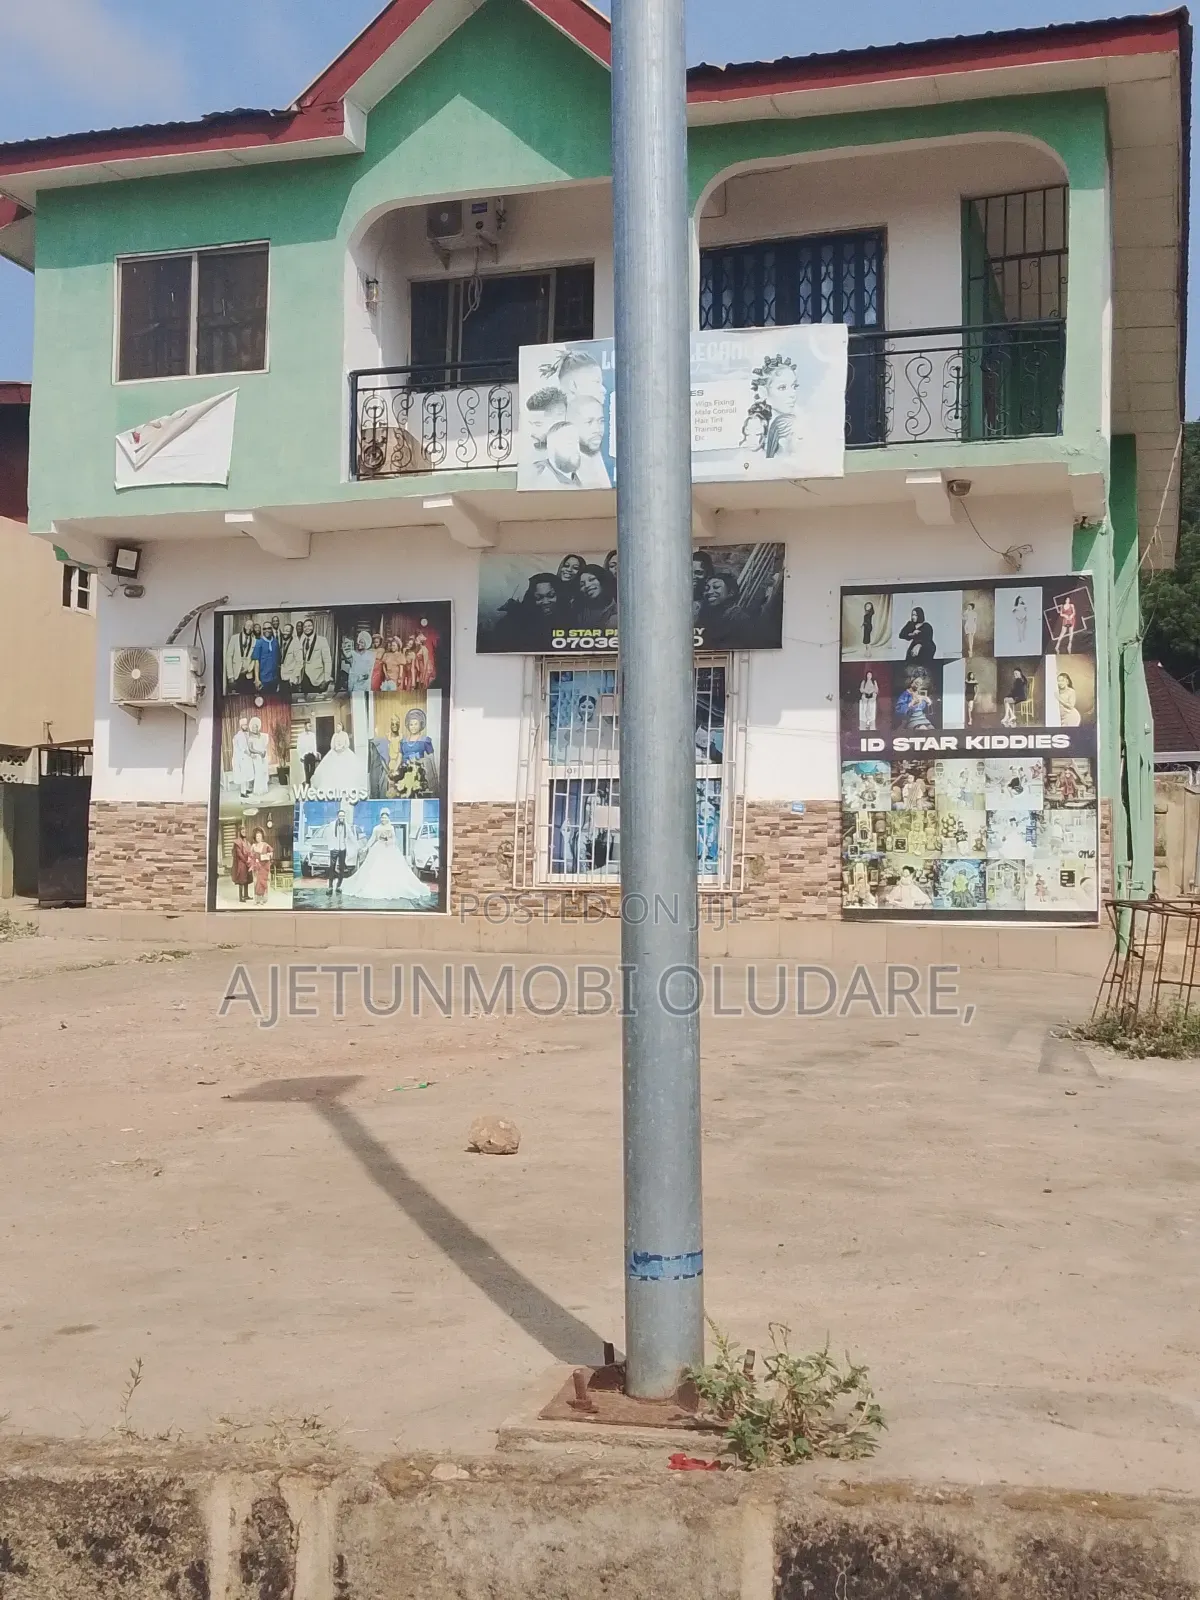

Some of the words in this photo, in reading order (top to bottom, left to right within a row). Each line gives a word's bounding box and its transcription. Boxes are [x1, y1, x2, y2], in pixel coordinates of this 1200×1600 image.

[695, 400, 712, 408] Wigs
[714, 399, 735, 407] Fixing
[694, 425, 723, 433] Training
[552, 629, 565, 637] ID
[569, 628, 602, 637] STAR
[860, 738, 885, 752] ID
[892, 737, 958, 752] STAR
[965, 734, 1070, 750] KIDDIES
[293, 783, 369, 805] Weddings
